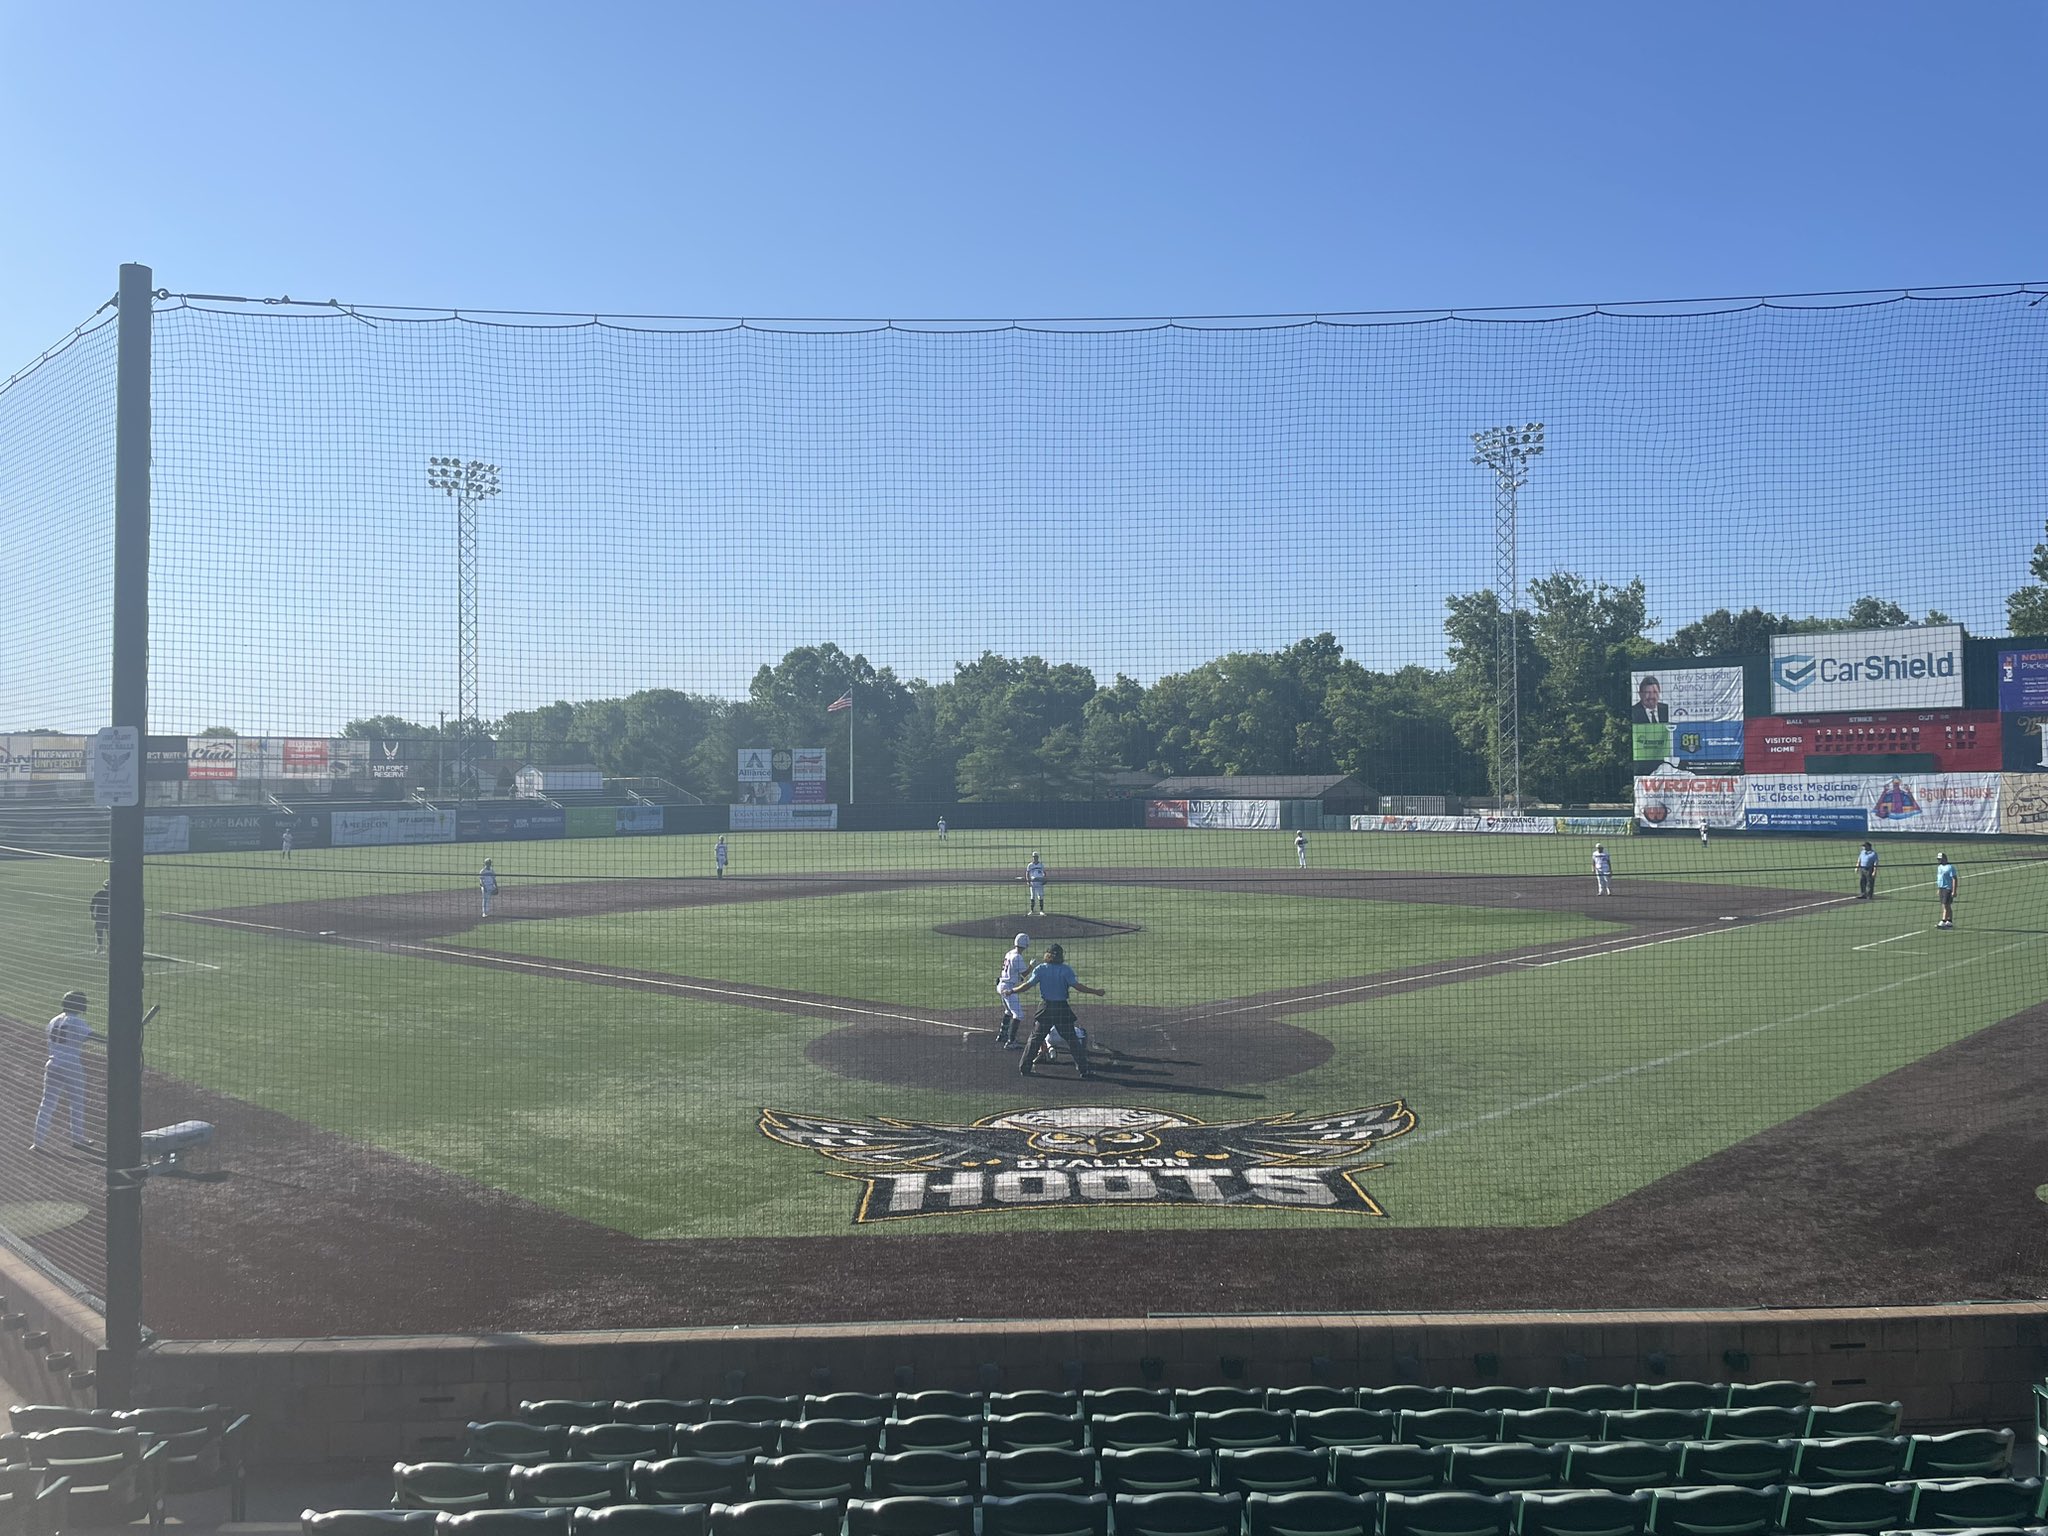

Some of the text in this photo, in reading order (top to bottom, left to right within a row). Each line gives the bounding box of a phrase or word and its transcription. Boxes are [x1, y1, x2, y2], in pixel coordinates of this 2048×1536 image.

[1820, 652, 1954, 682] CarShield
[1681, 733, 1700, 746] 811
[1764, 736, 1803, 744] VISITORS
[34, 750, 84, 759] LINDENWOOD
[1770, 745, 1796, 753] HOME
[34, 759, 83, 769] UNIVERSITY
[1638, 778, 1739, 793] WRIGHT
[1750, 781, 1858, 792] Your Best Medicine
[1758, 793, 1852, 803] is Close to Home
[1920, 787, 1994, 802] BOUNCE HOUSE
[341, 817, 389, 829] AMERICOM
[873, 1167, 1341, 1212] HOOTS
